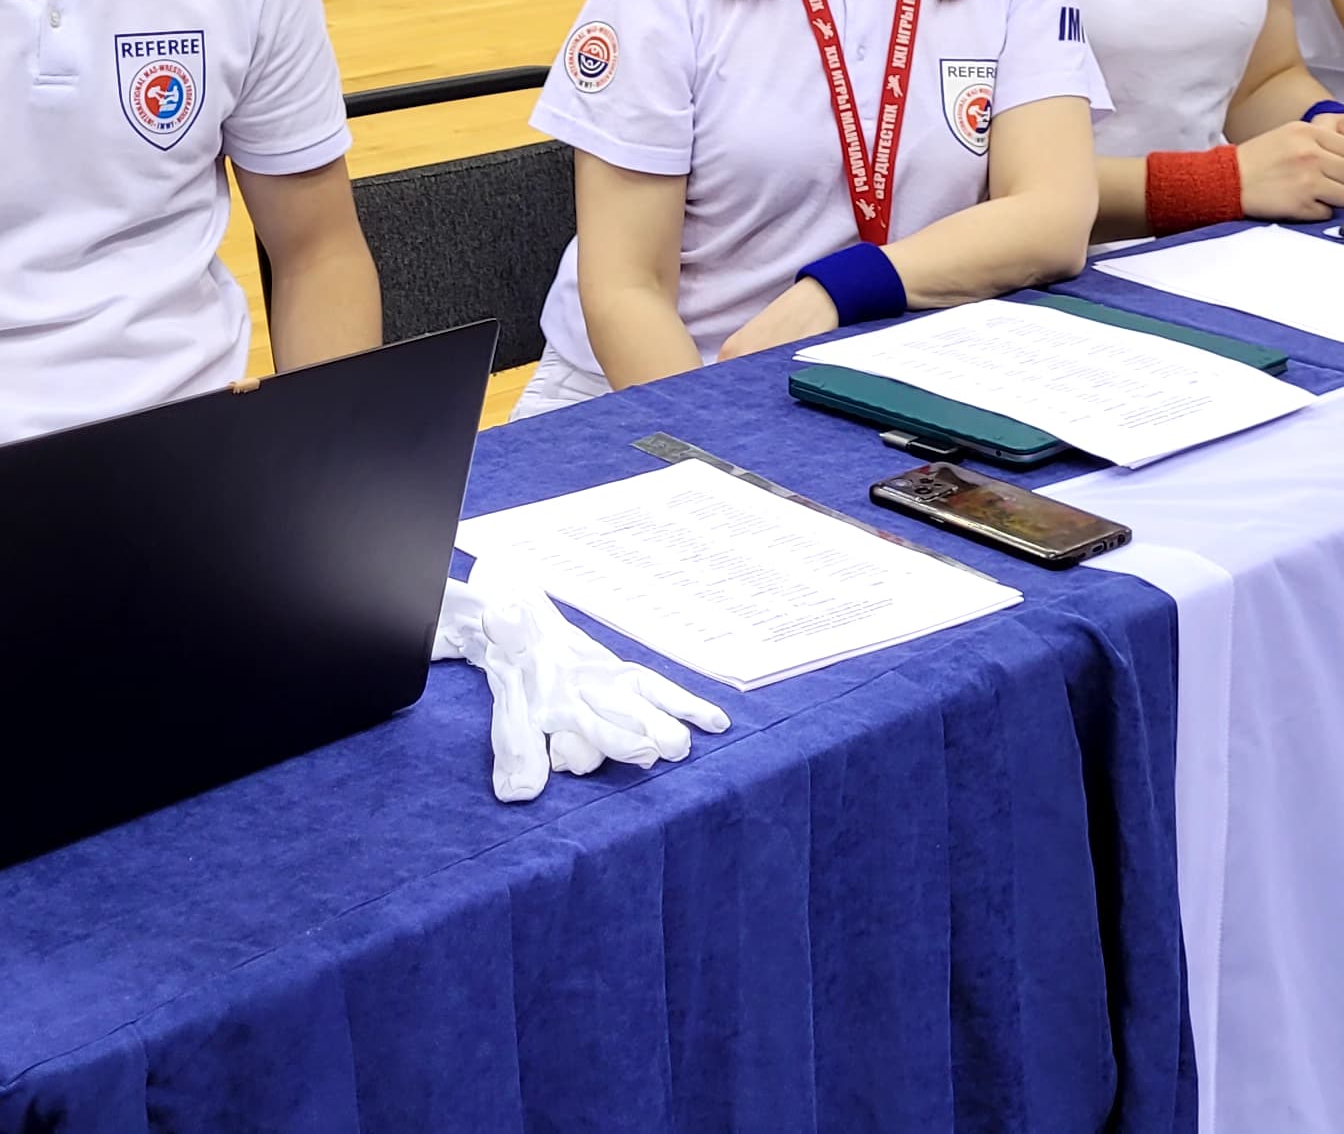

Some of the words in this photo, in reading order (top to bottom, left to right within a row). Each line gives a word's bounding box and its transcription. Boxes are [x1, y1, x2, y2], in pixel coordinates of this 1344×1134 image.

[1058, 6, 1086, 43] IM
[121, 38, 200, 59] REFEREE
[947, 65, 998, 79] REFER
